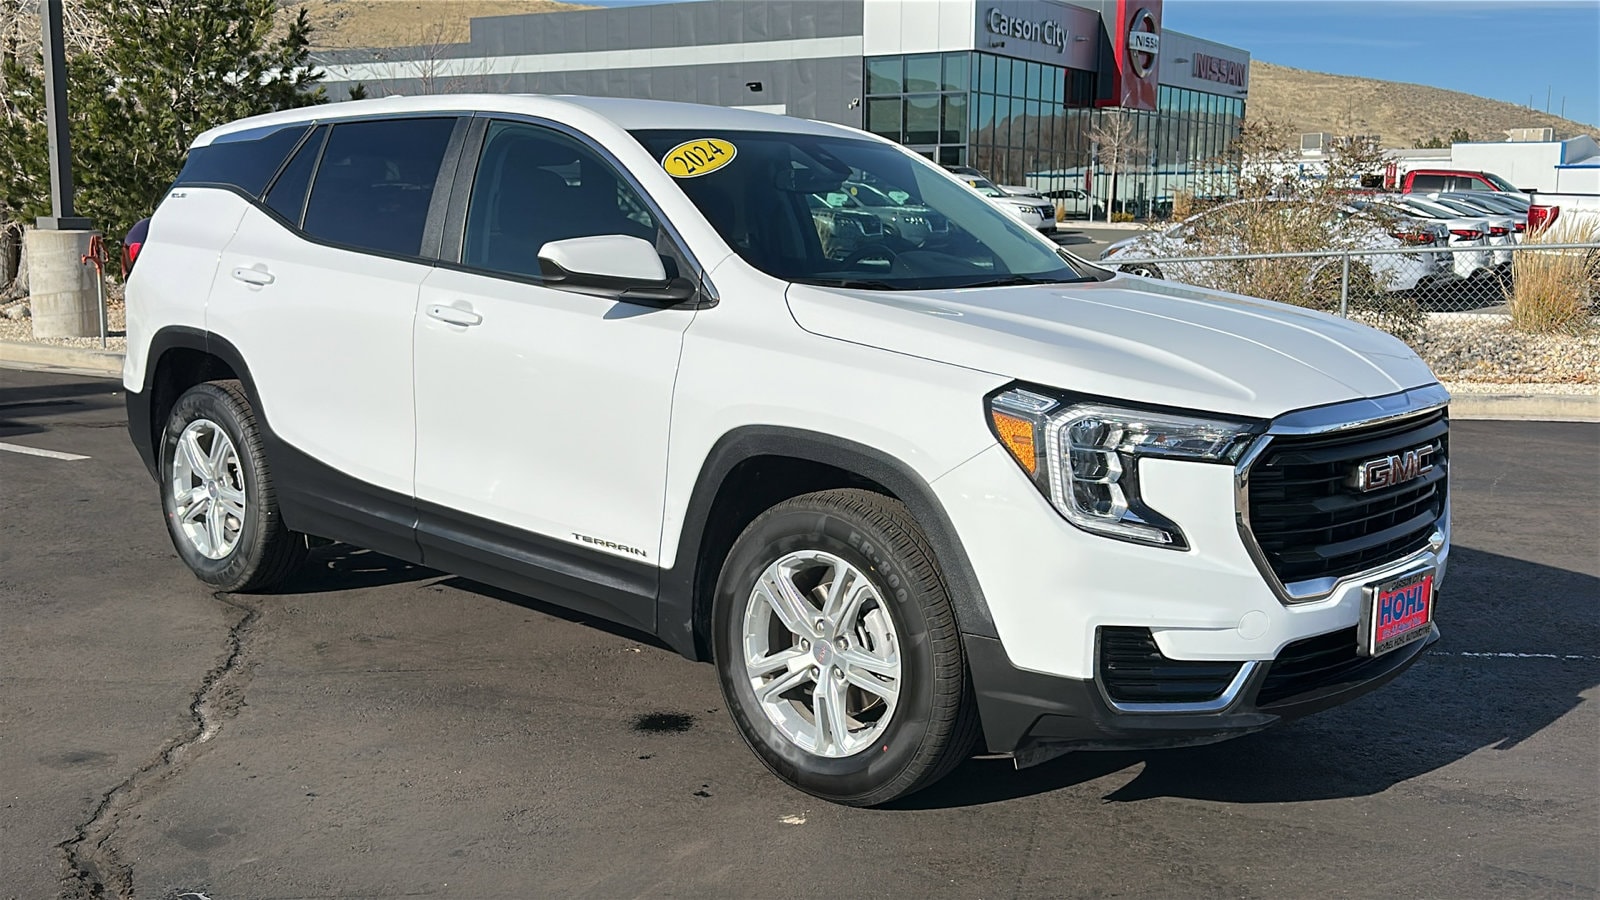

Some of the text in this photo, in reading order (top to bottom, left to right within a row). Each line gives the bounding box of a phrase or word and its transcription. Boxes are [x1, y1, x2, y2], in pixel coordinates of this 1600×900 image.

[988, 8, 1069, 54] Carson City
[1193, 52, 1246, 87] NISSAN
[673, 140, 725, 174] 2024
[1359, 445, 1434, 492] GMC
[571, 532, 648, 557] TERRAIN
[1380, 586, 1425, 628] HOHL
